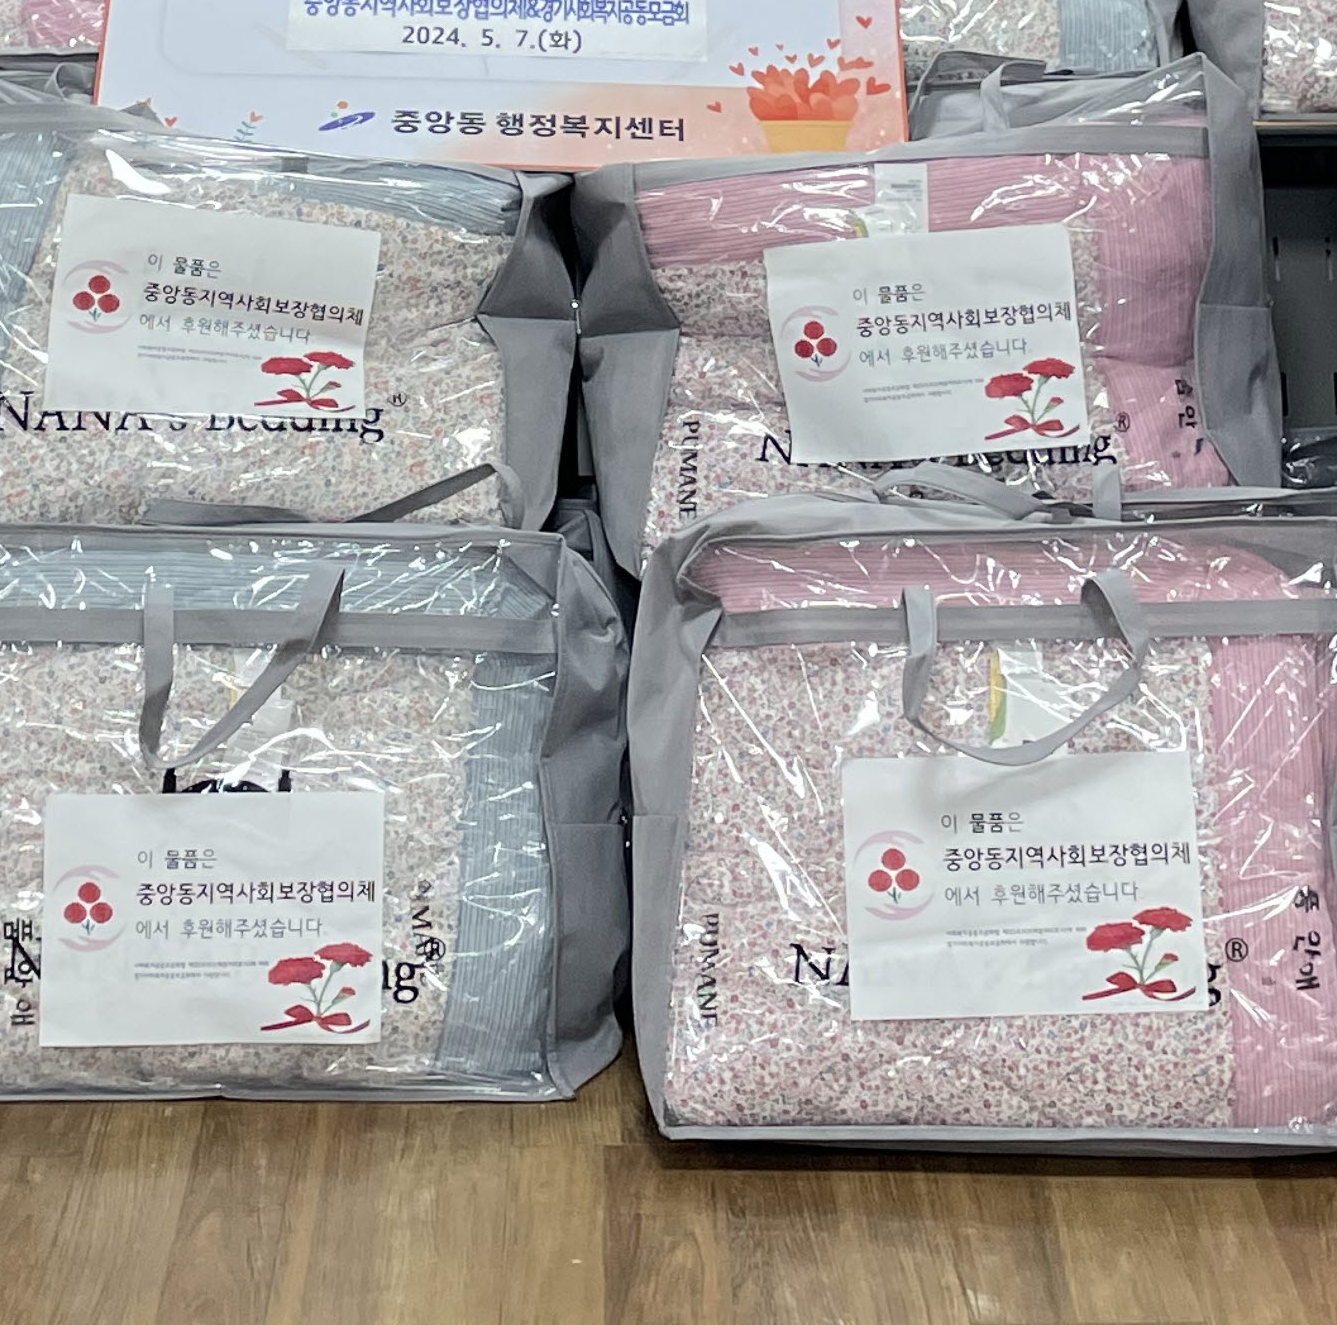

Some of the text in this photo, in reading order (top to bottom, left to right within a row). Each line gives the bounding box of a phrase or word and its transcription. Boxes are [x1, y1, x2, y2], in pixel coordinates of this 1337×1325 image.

[402, 26, 467, 49] 2024.
[481, 29, 501, 49] 5.
[392, 110, 686, 142] 중앙동 행정복지센터
[148, 253, 222, 279] 이 물품은
[143, 282, 364, 326] 중앙동지역사회보장협의체
[853, 282, 926, 306] 이 물품은
[139, 313, 171, 332] 에서
[857, 301, 1072, 338] 중앙동지역사회보장협의체
[859, 348, 891, 367] 에서
[941, 811, 1025, 836] 이 물품은
[137, 848, 219, 871] 이 물품은
[942, 841, 1192, 873] 중앙동지역사회보장협의체
[136, 880, 377, 907] 중앙동지역사회보장협의체
[944, 885, 981, 907] 에서
[135, 920, 170, 941] 에서
